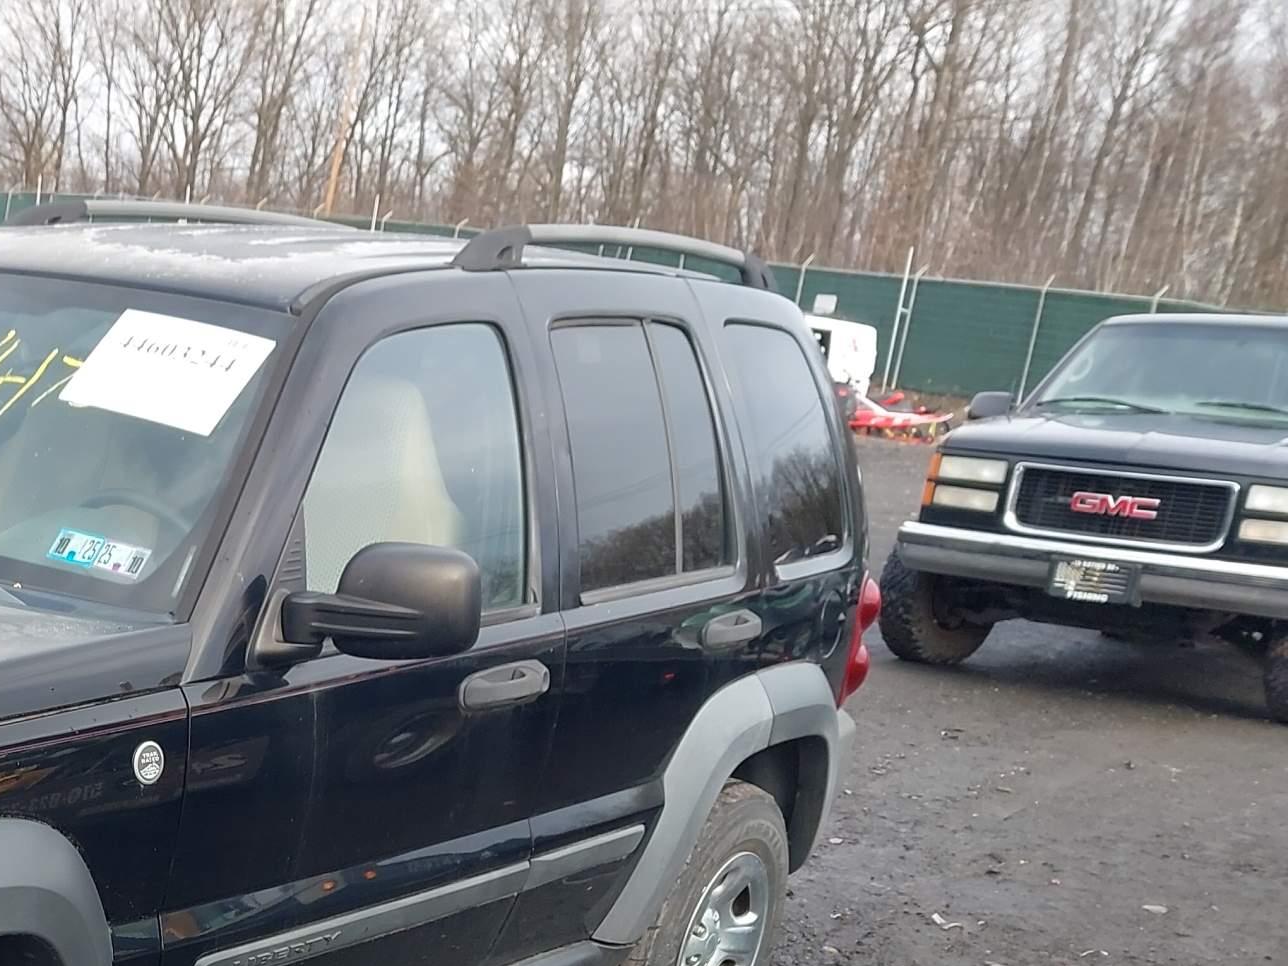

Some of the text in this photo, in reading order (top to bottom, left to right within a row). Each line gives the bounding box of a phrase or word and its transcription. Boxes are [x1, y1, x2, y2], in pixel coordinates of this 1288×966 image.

[1070, 491, 1161, 519] GMC
[98, 543, 145, 574] 25 10
